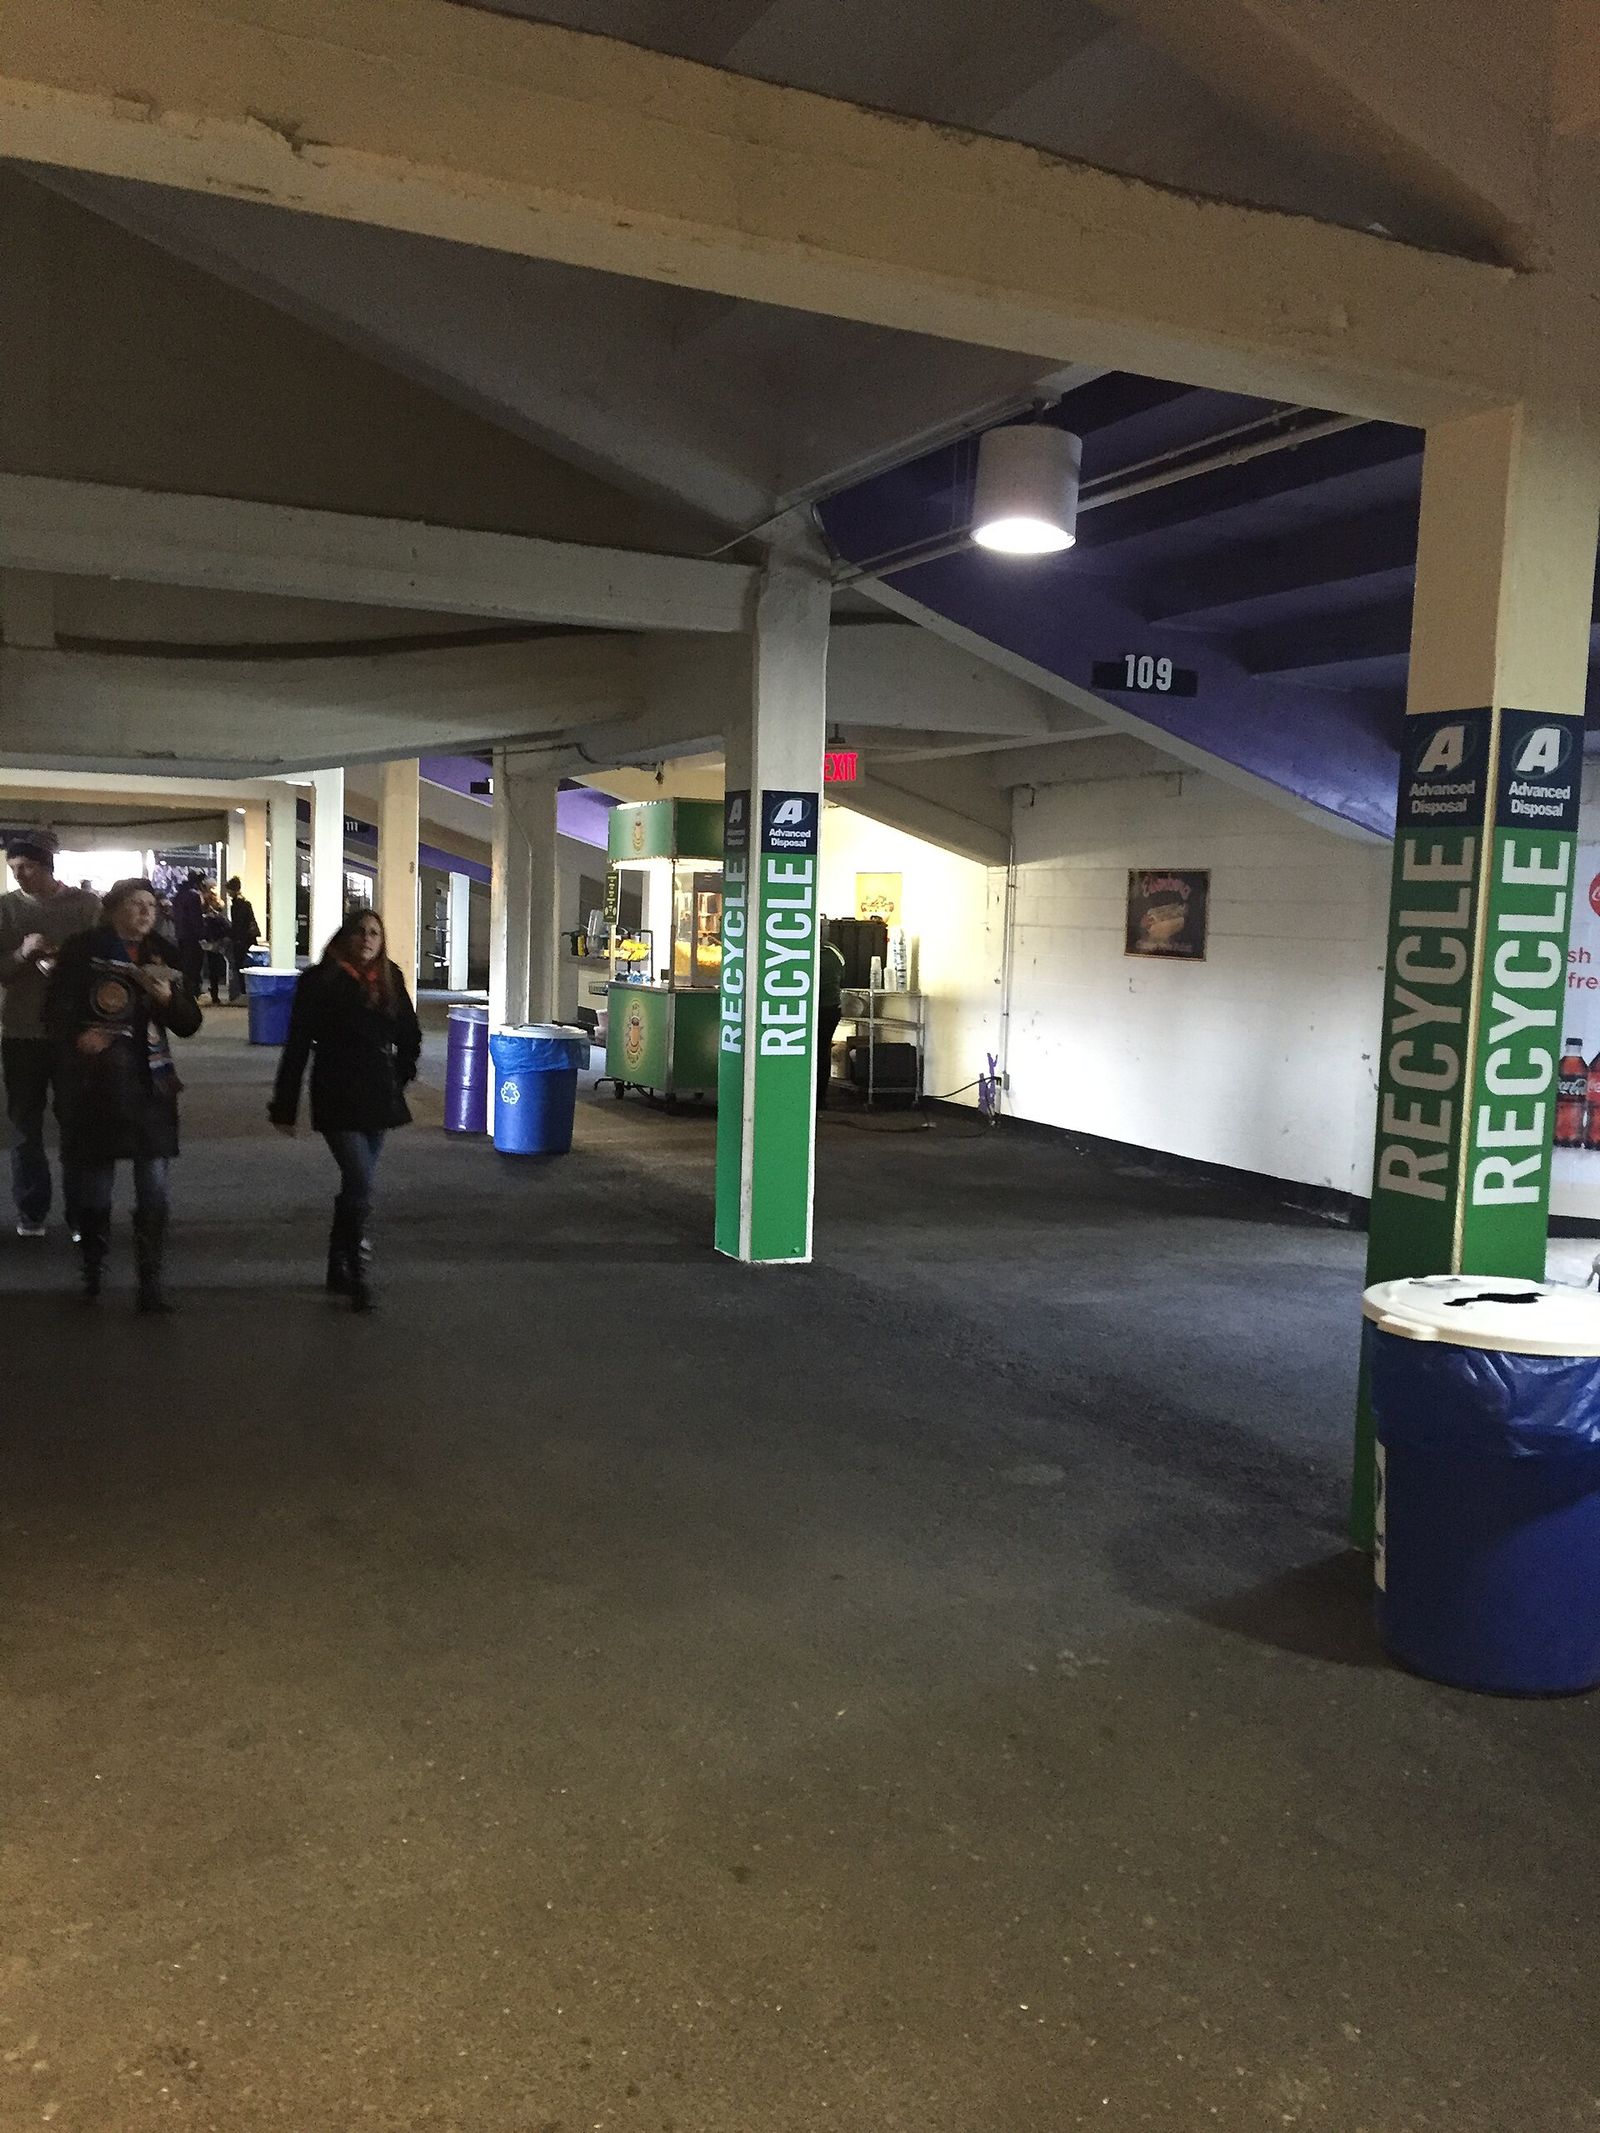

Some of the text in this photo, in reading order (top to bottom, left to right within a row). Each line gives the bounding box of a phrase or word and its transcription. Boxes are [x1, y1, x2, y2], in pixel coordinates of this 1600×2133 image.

[1125, 654, 1173, 691] 109
[1417, 725, 1465, 773] A
[1516, 728, 1561, 773] A
[824, 752, 858, 782] EXIT
[1409, 780, 1476, 797] Advanced
[1509, 781, 1571, 800] Advanced
[773, 799, 803, 824] A
[1412, 798, 1468, 816] Disposal
[1511, 799, 1564, 818] Disposal
[345, 821, 359, 832] 111
[769, 828, 811, 838] Advanced
[771, 838, 807, 848] Disposal
[721, 857, 746, 1054] RECYCLE
[760, 859, 814, 1057] RECYCLE
[1567, 947, 1591, 964] sh
[1568, 972, 1599, 990] fre
[1379, 836, 1477, 1202] RECYCLE
[1472, 839, 1571, 1207] RECYCLE
